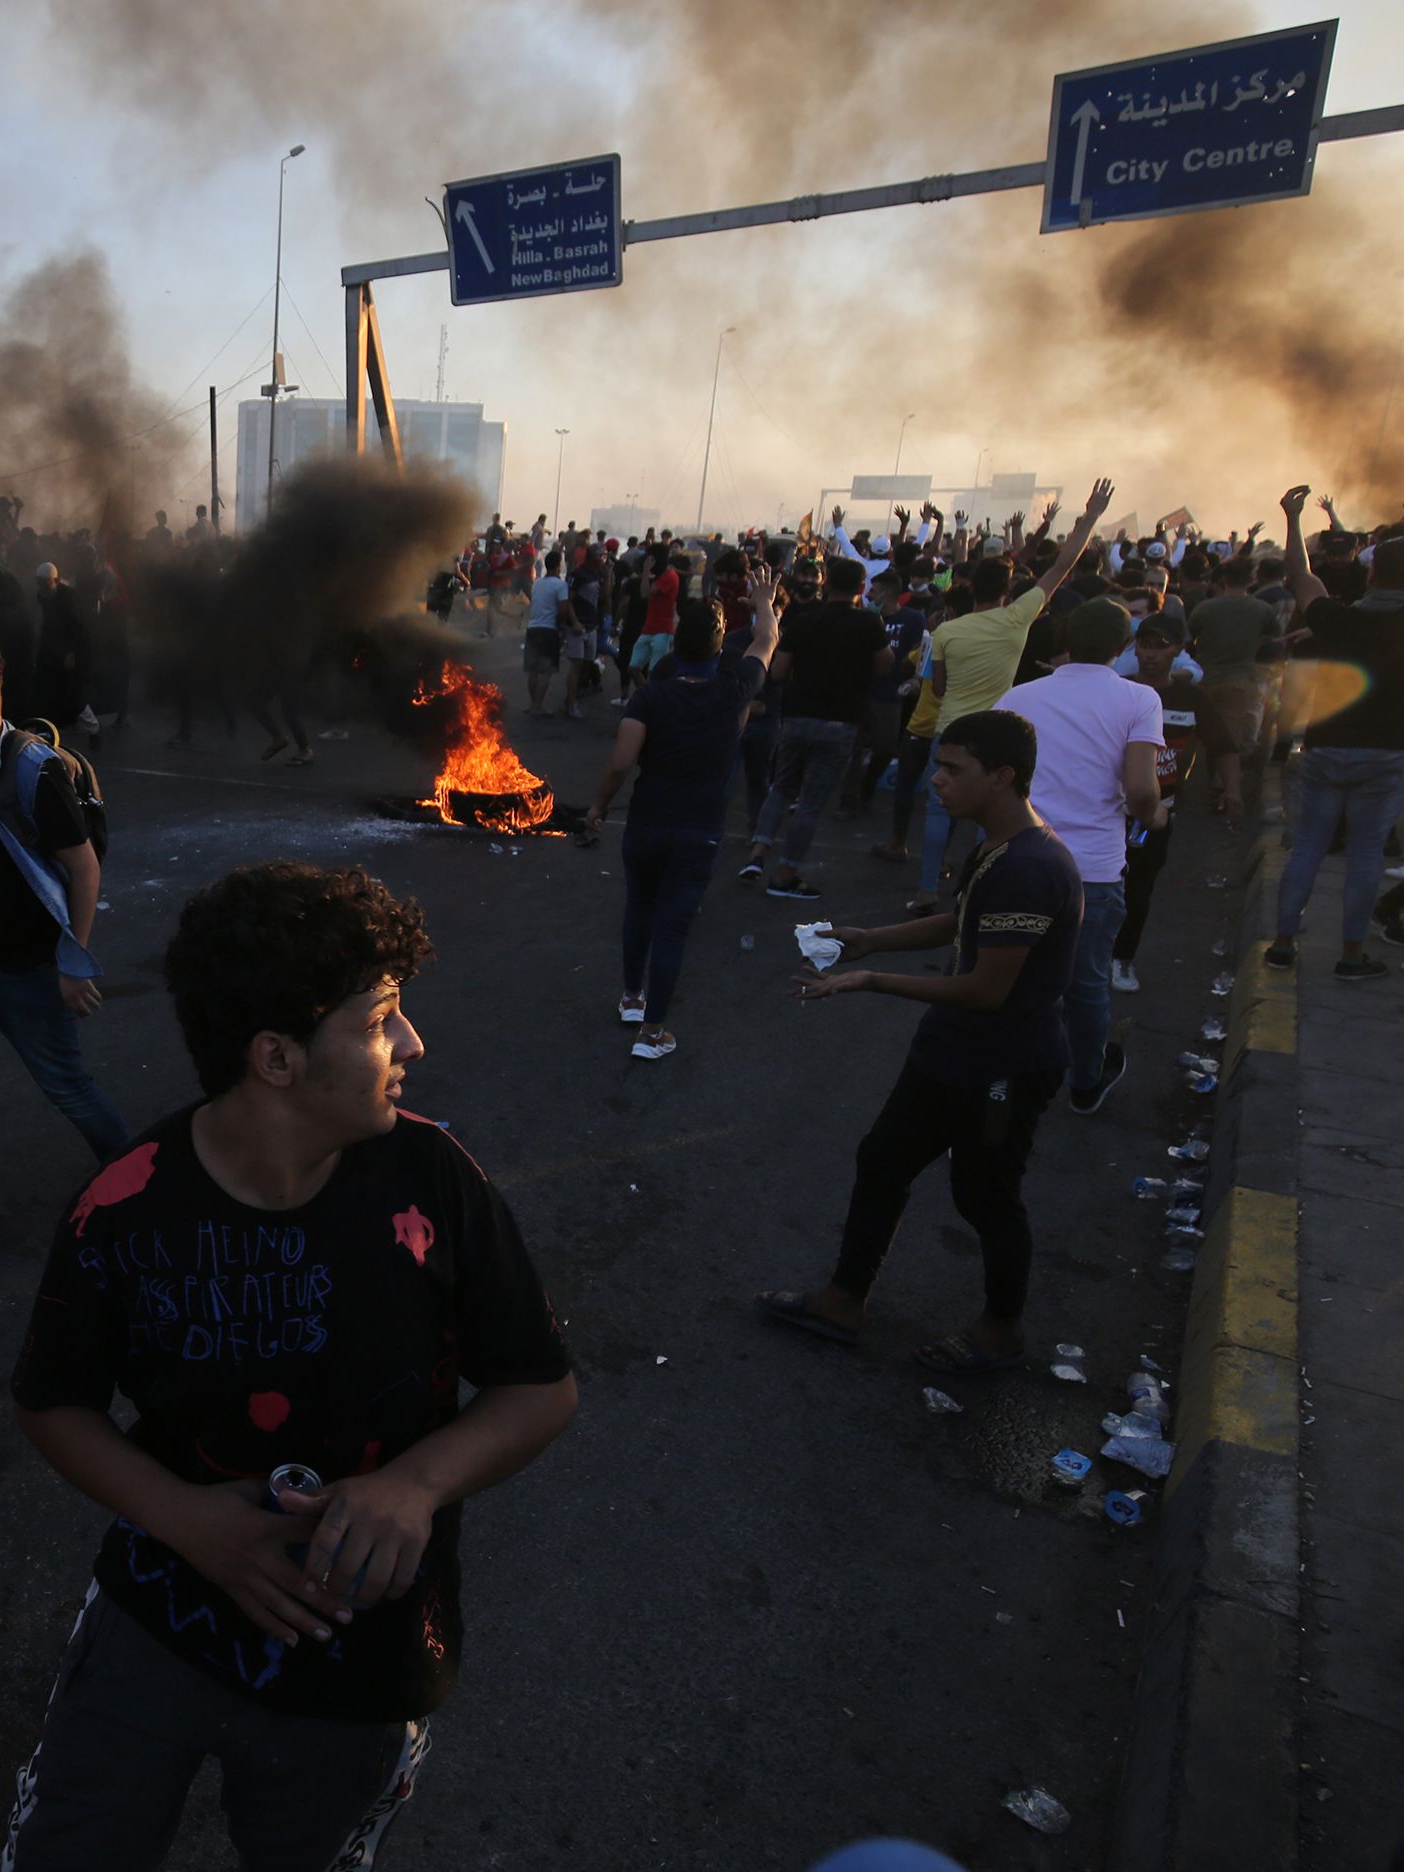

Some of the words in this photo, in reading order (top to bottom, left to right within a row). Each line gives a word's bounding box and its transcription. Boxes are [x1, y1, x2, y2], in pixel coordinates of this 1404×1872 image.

[1117, 80, 1219, 127] المدينة
[1222, 69, 1306, 111] مركز
[1106, 159, 1169, 184] City
[1183, 138, 1293, 172] Centre
[507, 184, 546, 210] بصرة
[509, 217, 564, 245] الجديدة
[571, 211, 608, 234] بغداد
[511, 250, 543, 266] Hilla
[554, 240, 608, 260] Basrah
